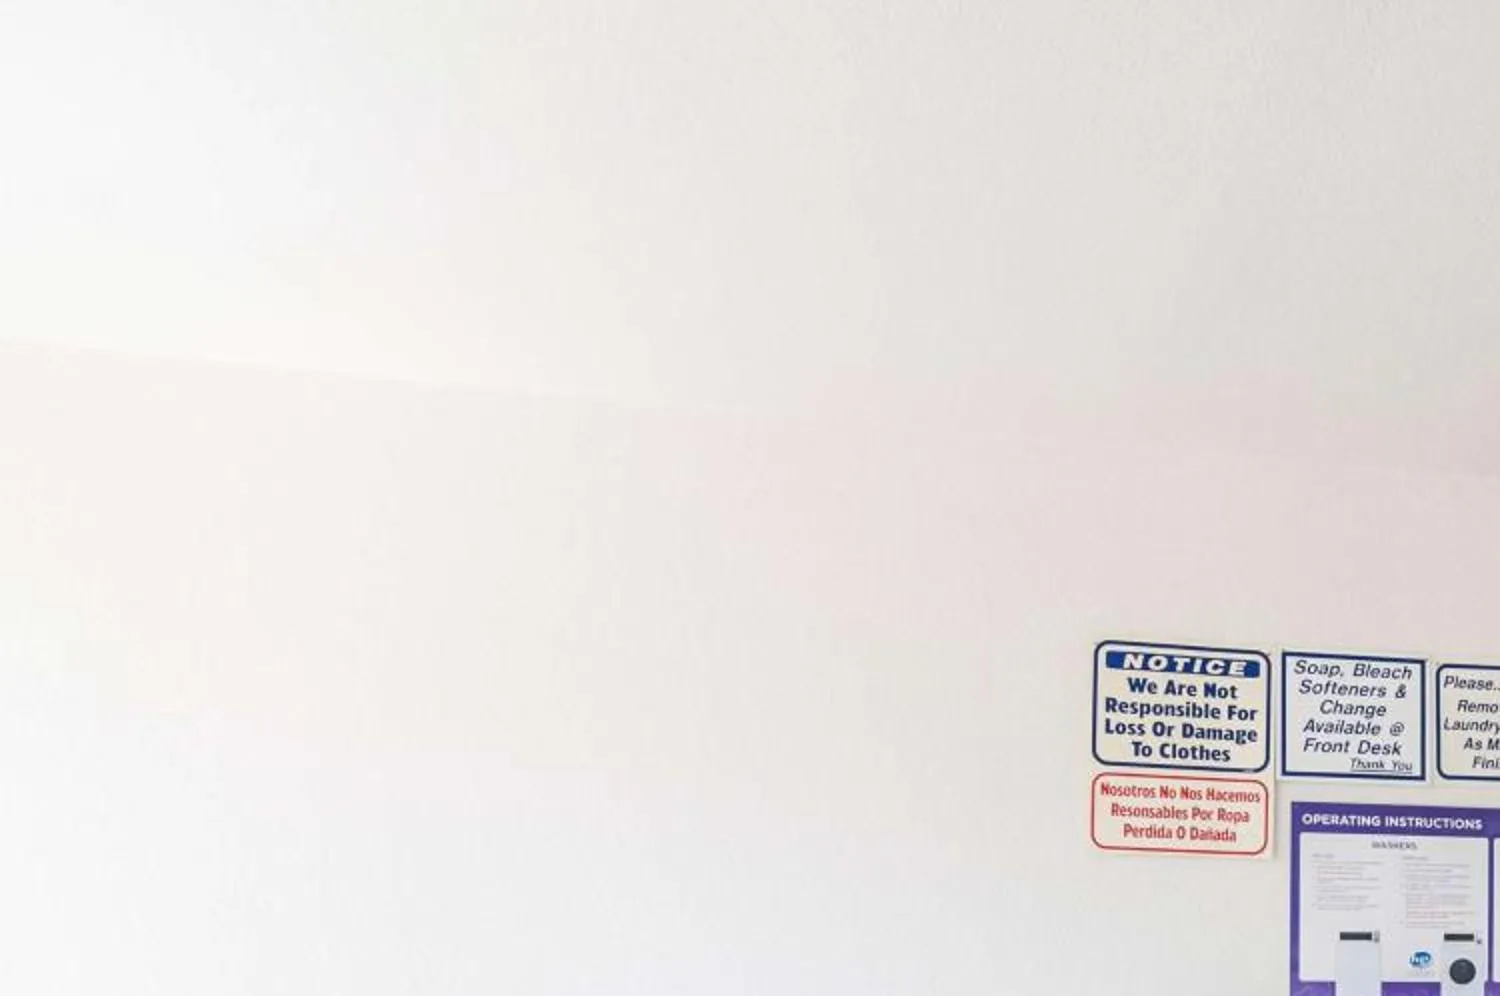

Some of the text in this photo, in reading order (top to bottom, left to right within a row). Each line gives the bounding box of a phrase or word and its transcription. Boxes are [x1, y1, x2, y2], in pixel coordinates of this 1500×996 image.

[1123, 654, 1246, 675] NOTICE
[1354, 663, 1412, 679] Bleach
[1128, 678, 1237, 699] We Are Not
[1298, 680, 1407, 699] Softeners &
[1106, 698, 1258, 721] Responsible For
[1320, 700, 1386, 719] Change
[1106, 718, 1258, 744] Loss Or Damage
[1304, 719, 1404, 736] Available @
[1132, 742, 1230, 761] To Clothes
[1303, 738, 1402, 756] Front Desk
[1464, 738, 1483, 750] As
[1350, 759, 1412, 772] Thank You
[1100, 783, 1260, 802] Nosotros No Nos Hacemos
[1112, 804, 1249, 824] Resonsables Por Ropa
[1302, 813, 1482, 830] OPERATING INSTRUCTIONS
[1124, 824, 1173, 839] Perdida
[1176, 826, 1186, 840] O
